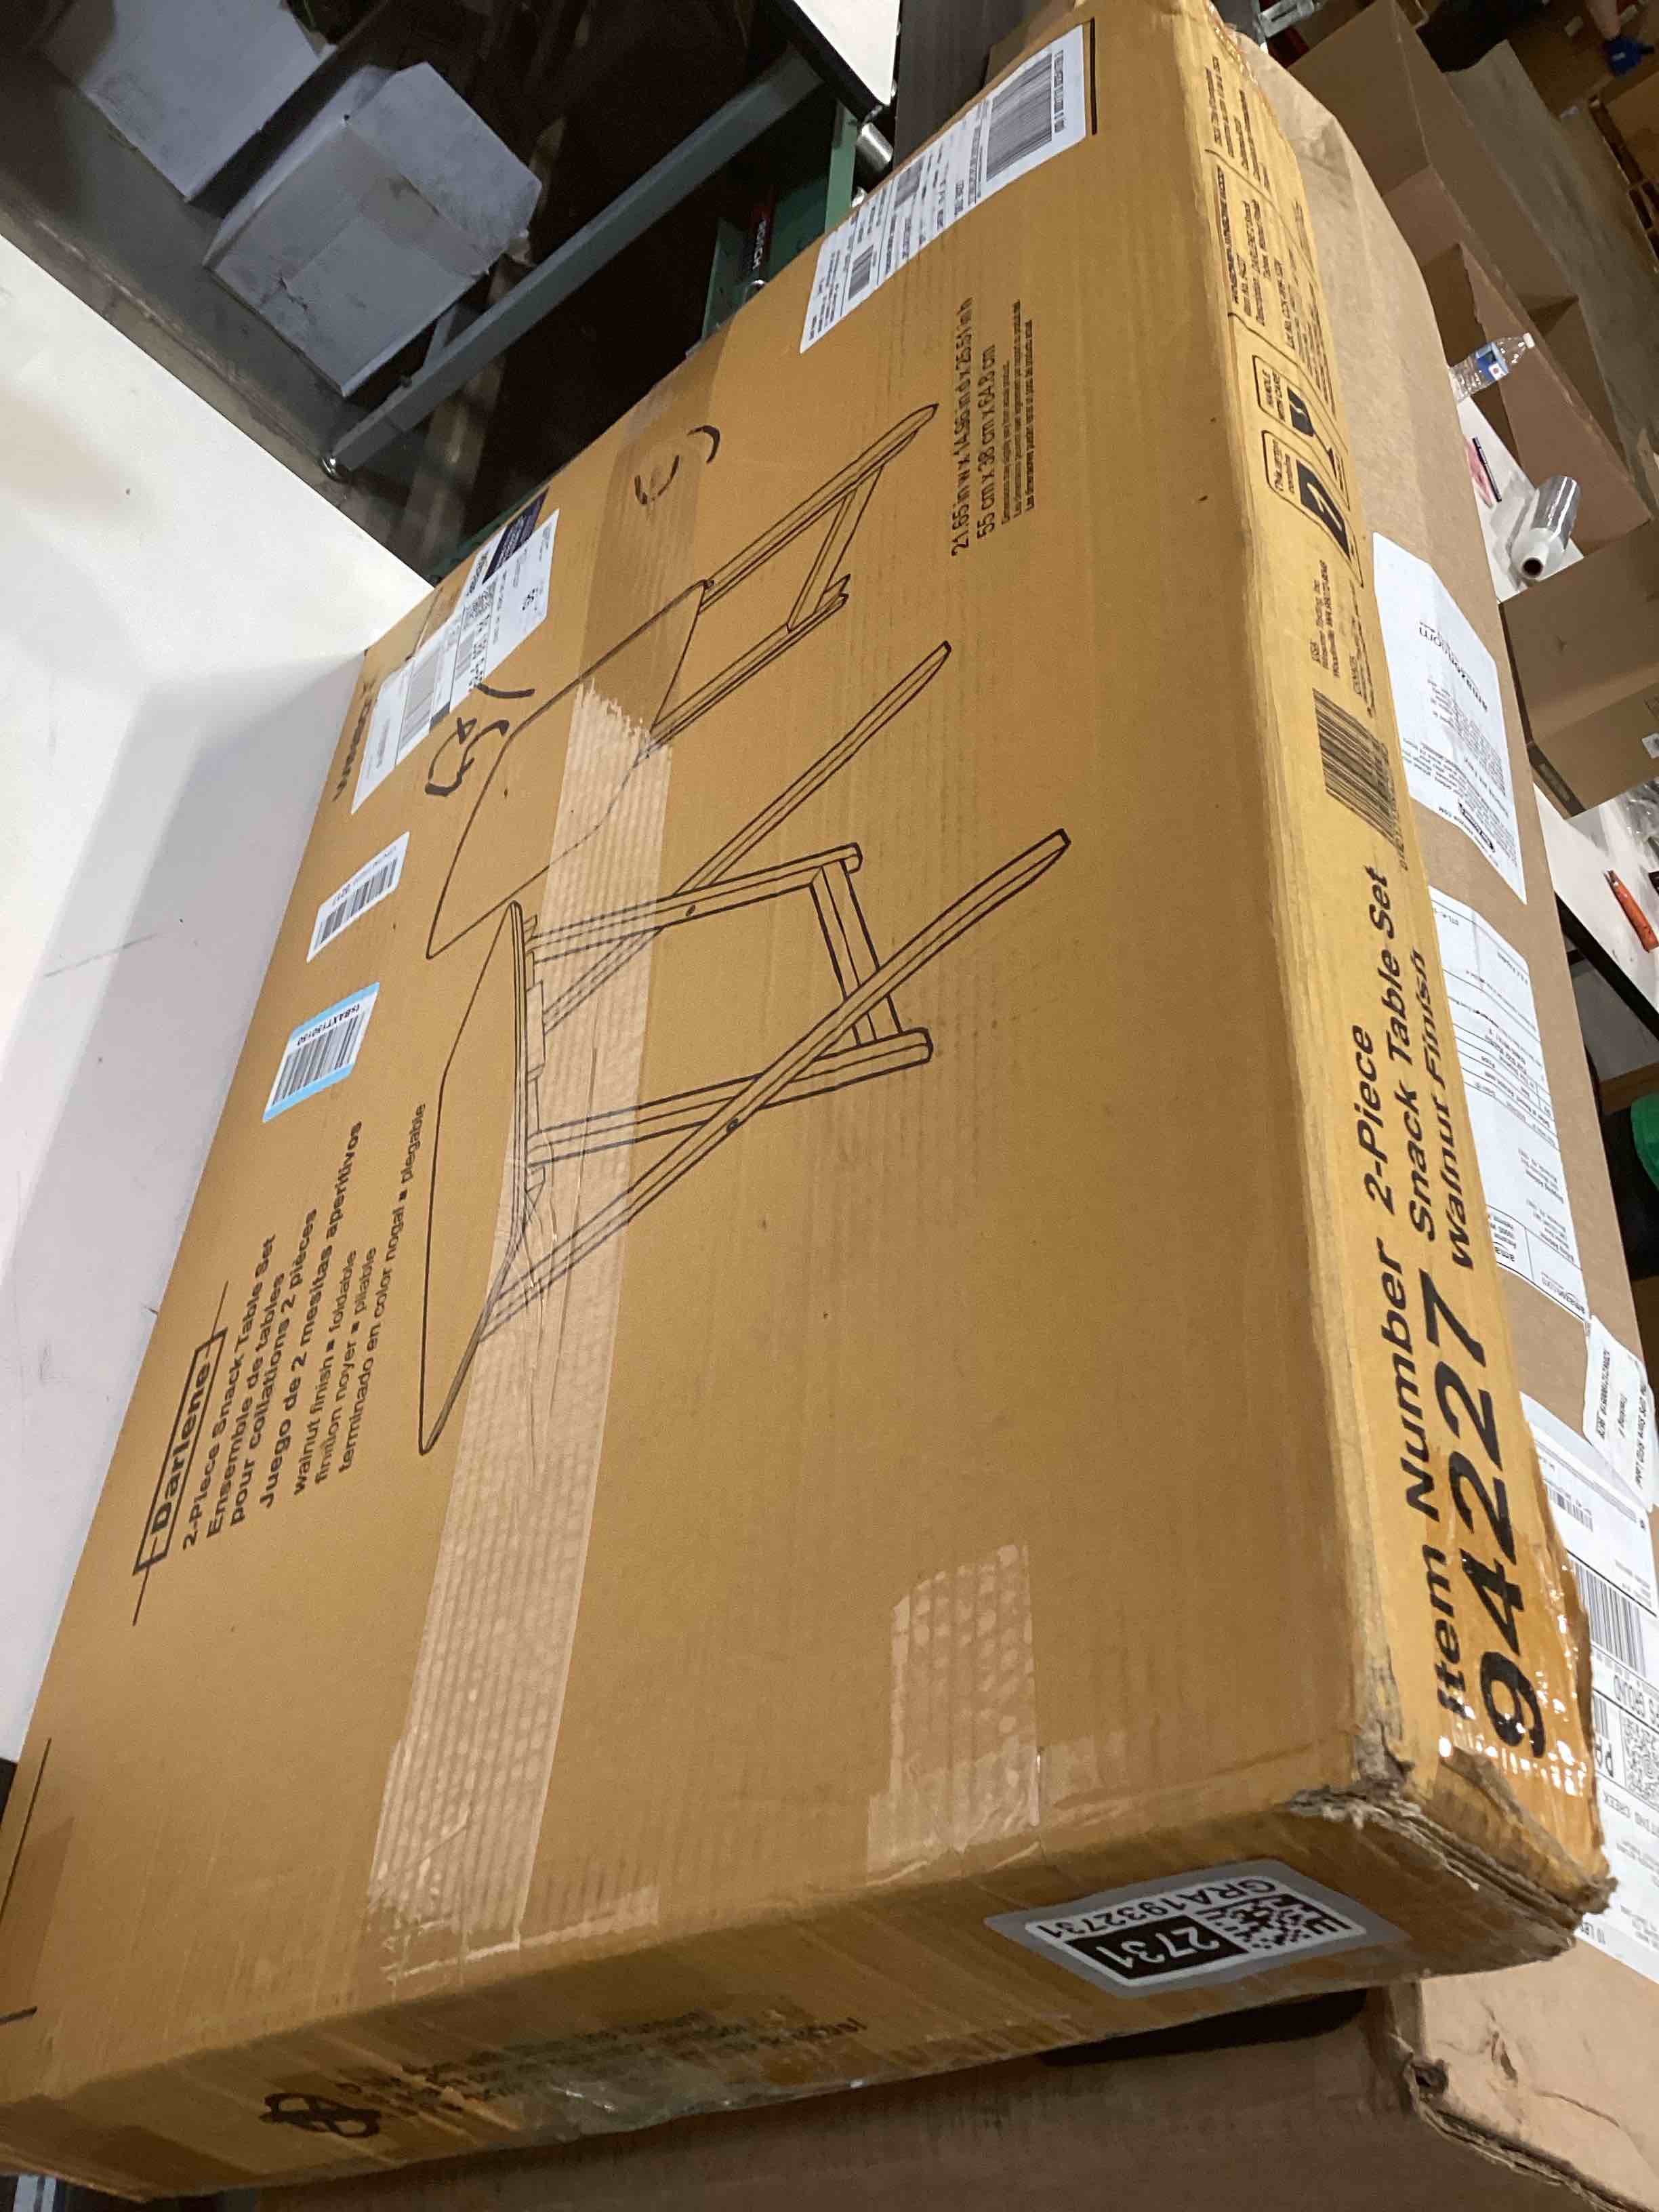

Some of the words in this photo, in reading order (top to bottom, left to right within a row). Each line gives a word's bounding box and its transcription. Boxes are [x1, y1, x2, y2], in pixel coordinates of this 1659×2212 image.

[982, 345, 995, 371] cm
[978, 446, 995, 472] 38
[982, 419, 995, 445] cm
[977, 512, 995, 539] 55
[981, 483, 995, 510] cm
[1364, 866, 1395, 940] Set
[1377, 949, 1413, 1066] Table
[1410, 945, 1446, 1090] Finish
[1351, 1025, 1395, 1216] 2-Piece
[1394, 1081, 1436, 1242] Snack
[326, 1122, 362, 1240] aperitivos
[300, 1245, 332, 1347] mesitas
[335, 1342, 356, 1402] noyer
[354, 1247, 376, 1315] pliable
[339, 1357, 373, 1473] terminado
[367, 1323, 381, 1352] en
[374, 1268, 392, 1319] color
[385, 1206, 405, 1262] nogal
[401, 1103, 426, 1184] plegable
[183, 1443, 220, 1551] 2-Piece
[212, 1353, 244, 1439] Snack
[234, 1282, 262, 1351] Table
[255, 1234, 275, 1278] Set
[206, 1397, 253, 1538] Ensemble
[247, 1357, 263, 1390] de
[255, 1273, 285, 1352] tables
[230, 1459, 255, 1526] pour
[249, 1317, 289, 1450] collations
[281, 1294, 296, 1313] 2
[289, 1209, 316, 1289] pièces
[283, 1377, 301, 1411] de
[291, 1352, 307, 1372] 2
[294, 1418, 320, 1495] walnut
[310, 1355, 334, 1414] finish
[329, 1250, 356, 1332] foldable
[1376, 1236, 1441, 1523] Number
[150, 1362, 210, 1535] Darlene
[260, 1419, 291, 1509] Juego
[1418, 1267, 1547, 1760] 94227
[1421, 1544, 1467, 1720] Item
[1035, 1878, 1277, 1940] GRA1932731
[1095, 1926, 1221, 1969] 2731
